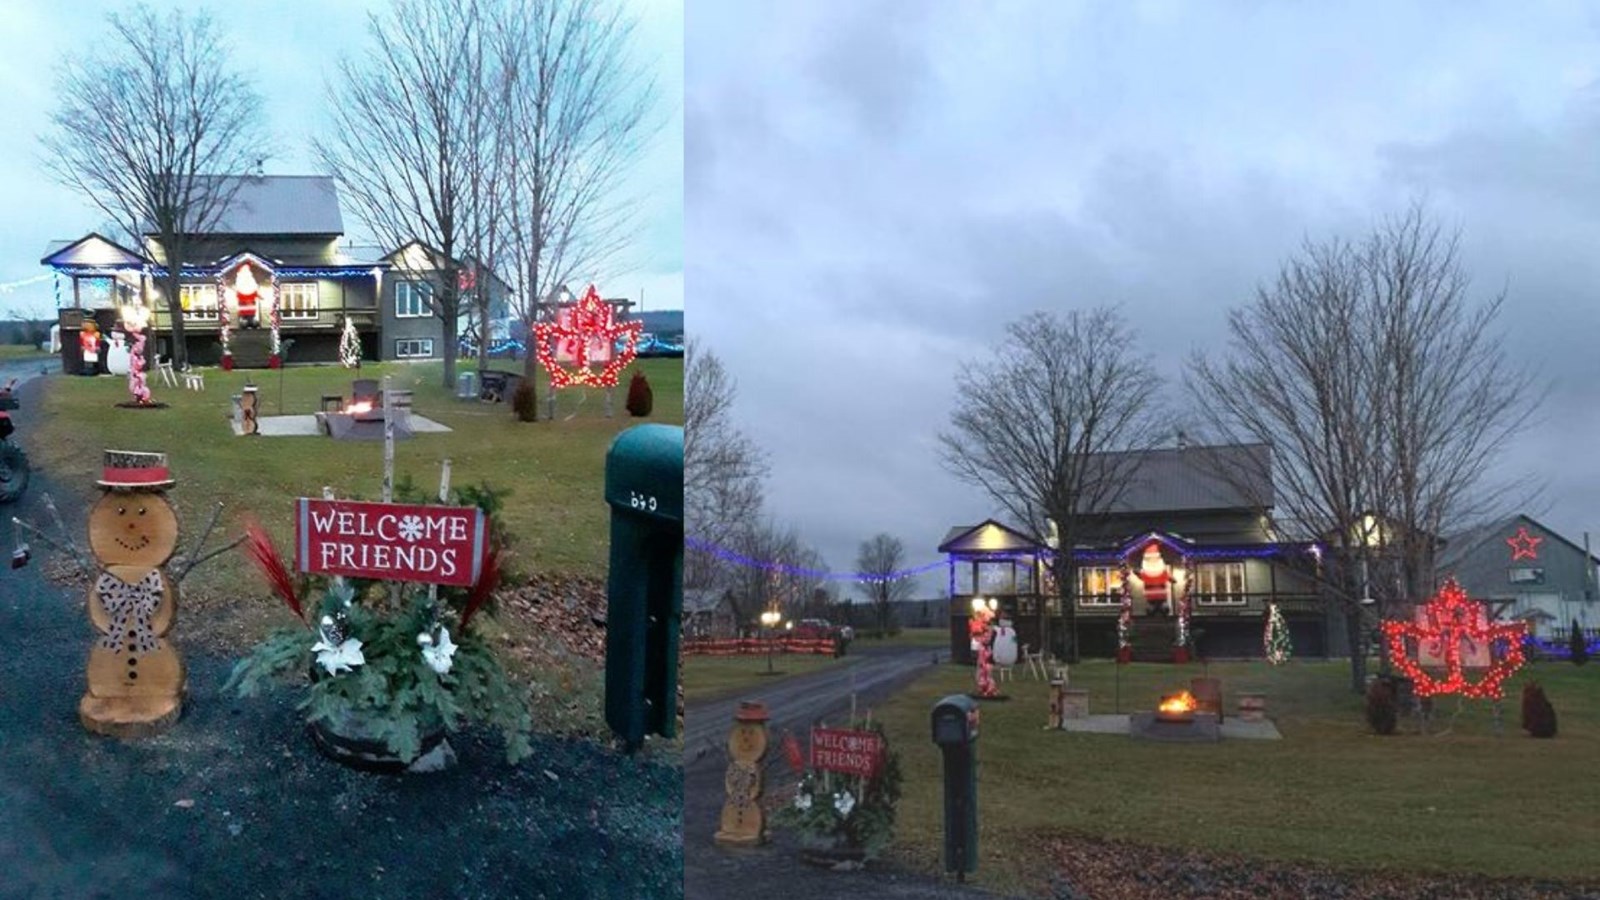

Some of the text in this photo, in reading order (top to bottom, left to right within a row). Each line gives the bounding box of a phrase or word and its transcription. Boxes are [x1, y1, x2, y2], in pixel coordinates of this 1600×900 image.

[311, 509, 467, 545] WELCOME
[321, 542, 456, 576] FRIENDS
[817, 751, 871, 771] FRIENDS
